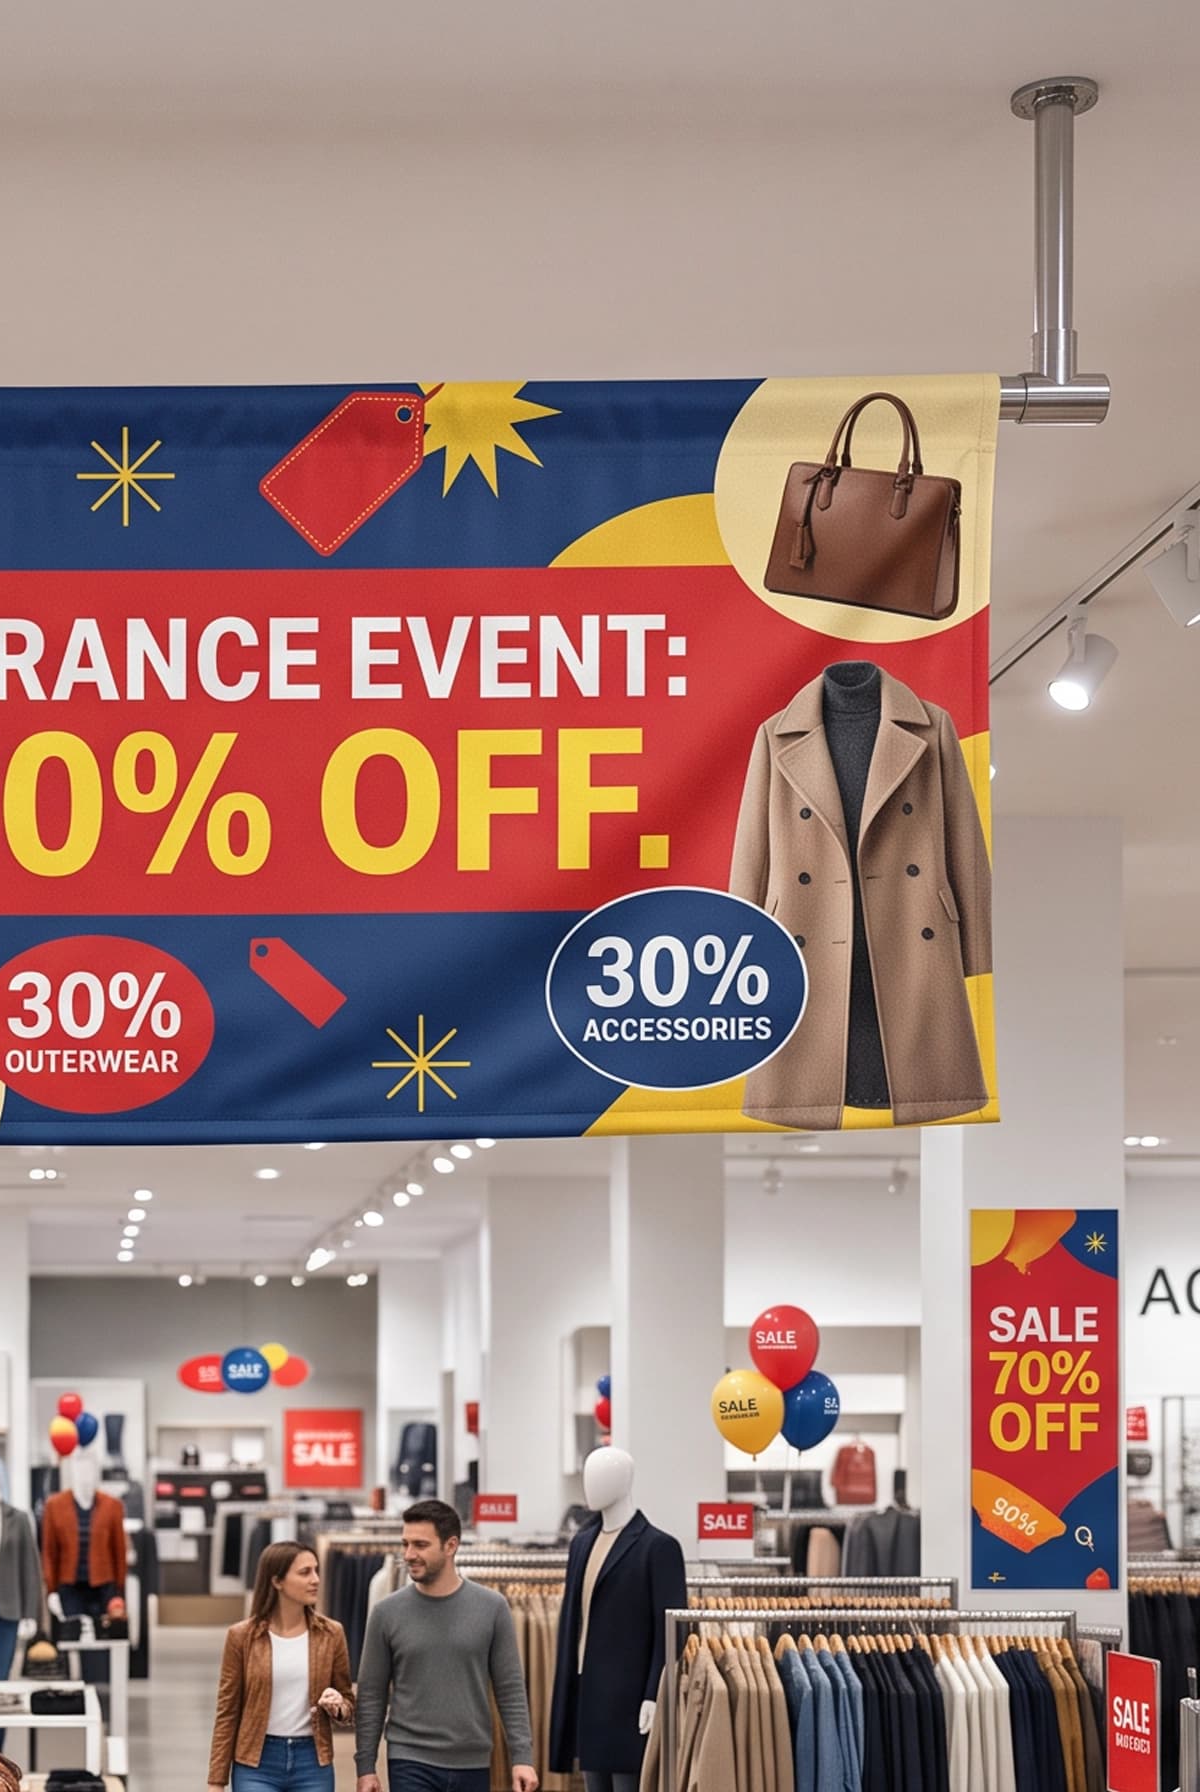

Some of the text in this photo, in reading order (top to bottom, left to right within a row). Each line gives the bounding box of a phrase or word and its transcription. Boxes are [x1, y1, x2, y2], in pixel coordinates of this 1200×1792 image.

[351, 614, 687, 699] EVENT:
[321, 728, 670, 876] OFF.
[586, 935, 769, 1008] 30%
[7, 971, 181, 1039] 30%
[582, 1017, 772, 1042] ACCESSORIES
[5, 1049, 179, 1073] OUTERWEAR
[756, 1331, 796, 1344] SALE
[989, 1306, 1099, 1343] SALE
[989, 1350, 1100, 1396] 70%
[719, 1398, 758, 1414] SALE
[989, 1402, 1099, 1452] OFF
[292, 1443, 356, 1467] SALE
[703, 1514, 748, 1531] SALE
[1113, 1696, 1150, 1736] SALE
